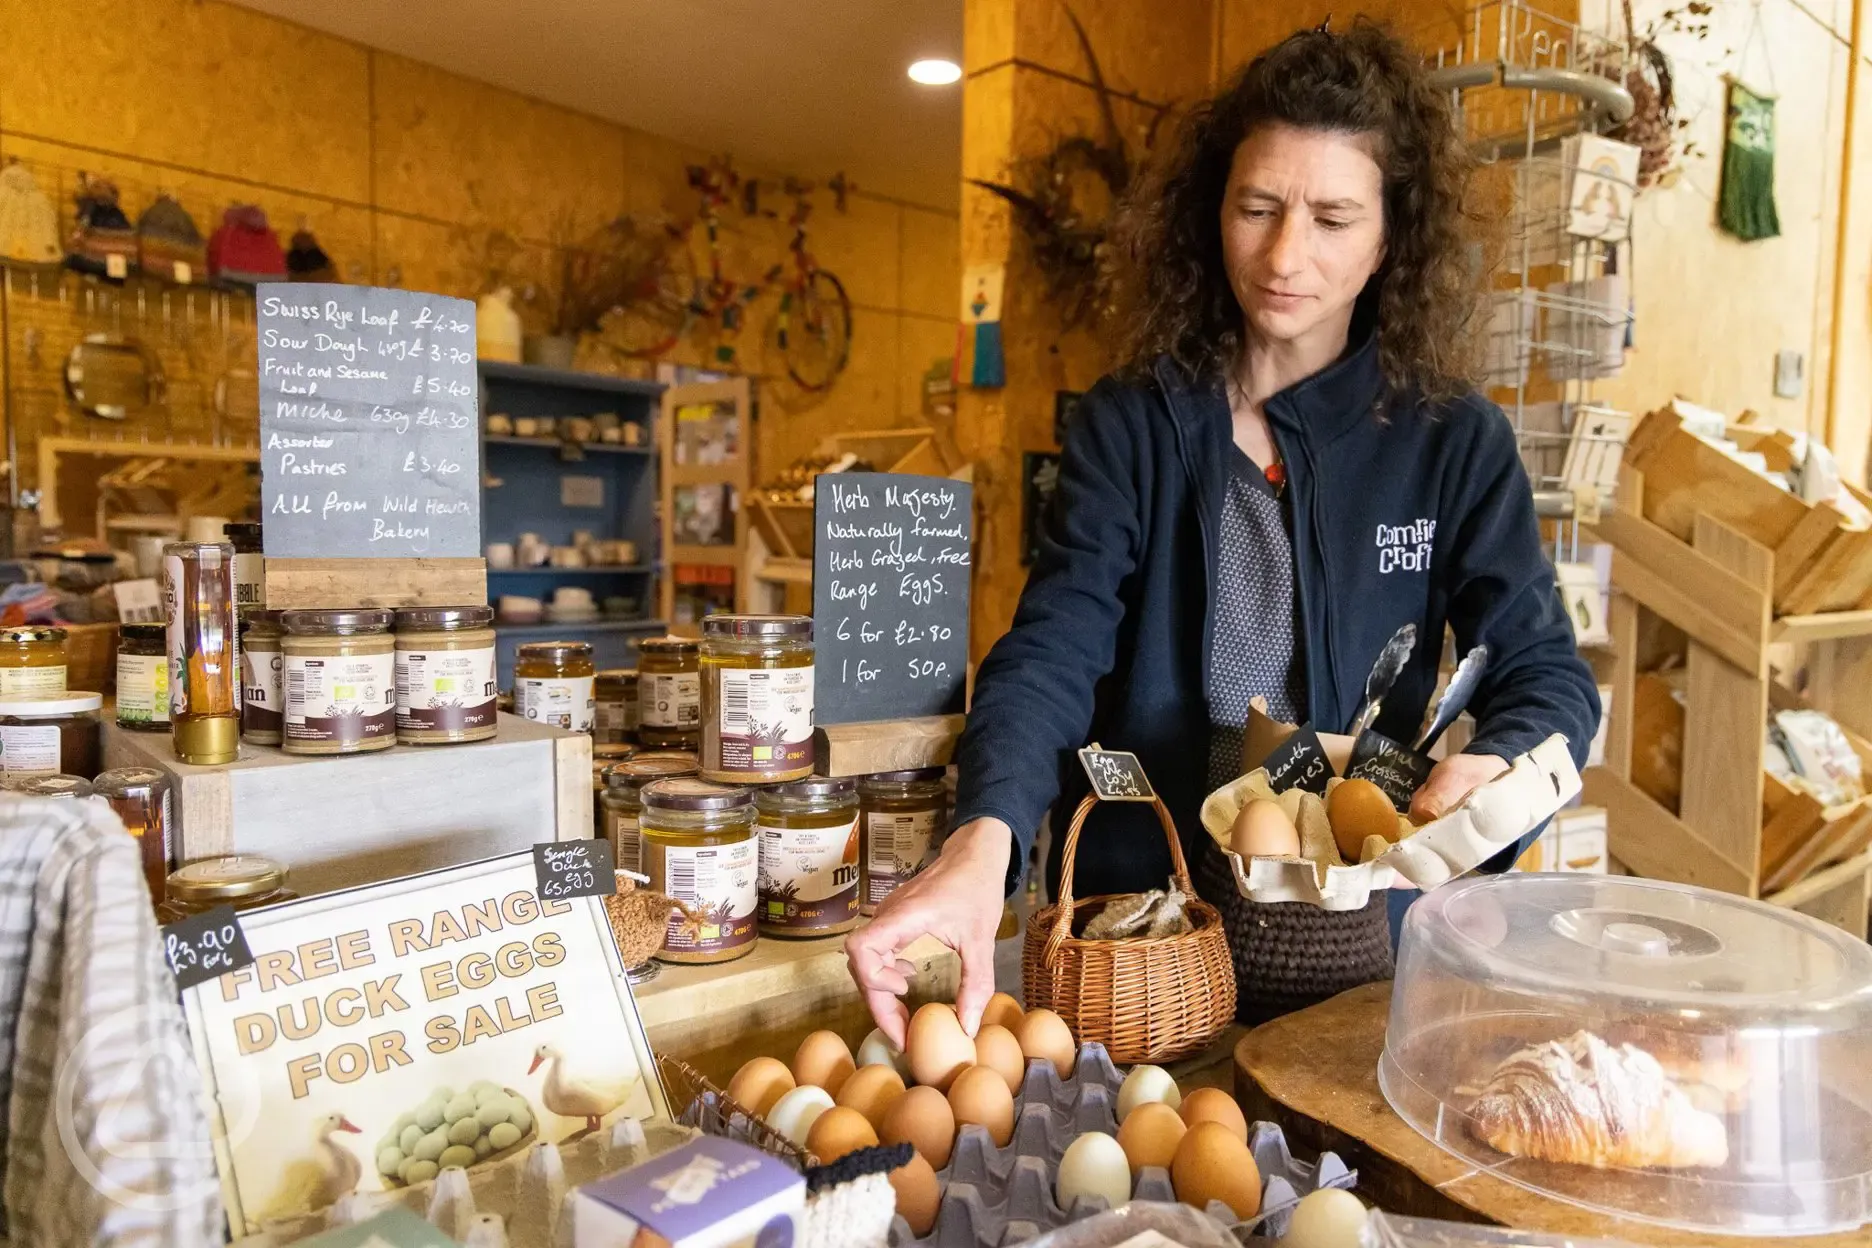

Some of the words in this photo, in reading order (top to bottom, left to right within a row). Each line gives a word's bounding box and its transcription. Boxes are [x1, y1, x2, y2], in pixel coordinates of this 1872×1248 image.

[263, 298, 320, 320] Swiss
[325, 301, 353, 329] Rye
[361, 308, 398, 334] Loaf
[264, 330, 308, 348] Sour
[315, 334, 368, 361] Dough
[264, 358, 301, 377] Fruit
[307, 366, 332, 379] and
[336, 367, 388, 380] Sesame
[280, 380, 317, 396] Loaf
[277, 402, 348, 423] Miche
[370, 406, 409, 434] 630g
[416, 407, 469, 428] £4.30
[280, 453, 347, 475] Pastries
[272, 494, 312, 514] All
[323, 491, 367, 520] from
[383, 496, 417, 513] Wild
[425, 499, 471, 516] Hearth
[832, 484, 869, 512] Herb
[369, 518, 429, 551] Bakery
[827, 521, 902, 557] Naturally
[1376, 518, 1437, 547] Comrie
[831, 551, 863, 571] Herb
[1379, 543, 1433, 574] Croft
[831, 580, 877, 610] Range
[837, 617, 850, 640] 6
[860, 623, 884, 643] for
[895, 620, 951, 646] £2.80
[842, 660, 847, 683] 1
[857, 660, 881, 682] for
[1090, 753, 1117, 775] Egg
[1266, 742, 1311, 786] hearth
[1378, 740, 1416, 770] Vegan
[544, 846, 589, 864] Single
[544, 880, 572, 895] 65p
[565, 871, 594, 889] egg
[167, 925, 235, 975] £3.90
[219, 929, 376, 1002] FREE
[387, 890, 573, 957] RANGE
[223, 952, 233, 966] 6
[233, 973, 410, 1056] DUCK
[420, 932, 567, 1002] EGGS
[287, 1030, 414, 1100] FOR
[424, 981, 564, 1055] SALE
